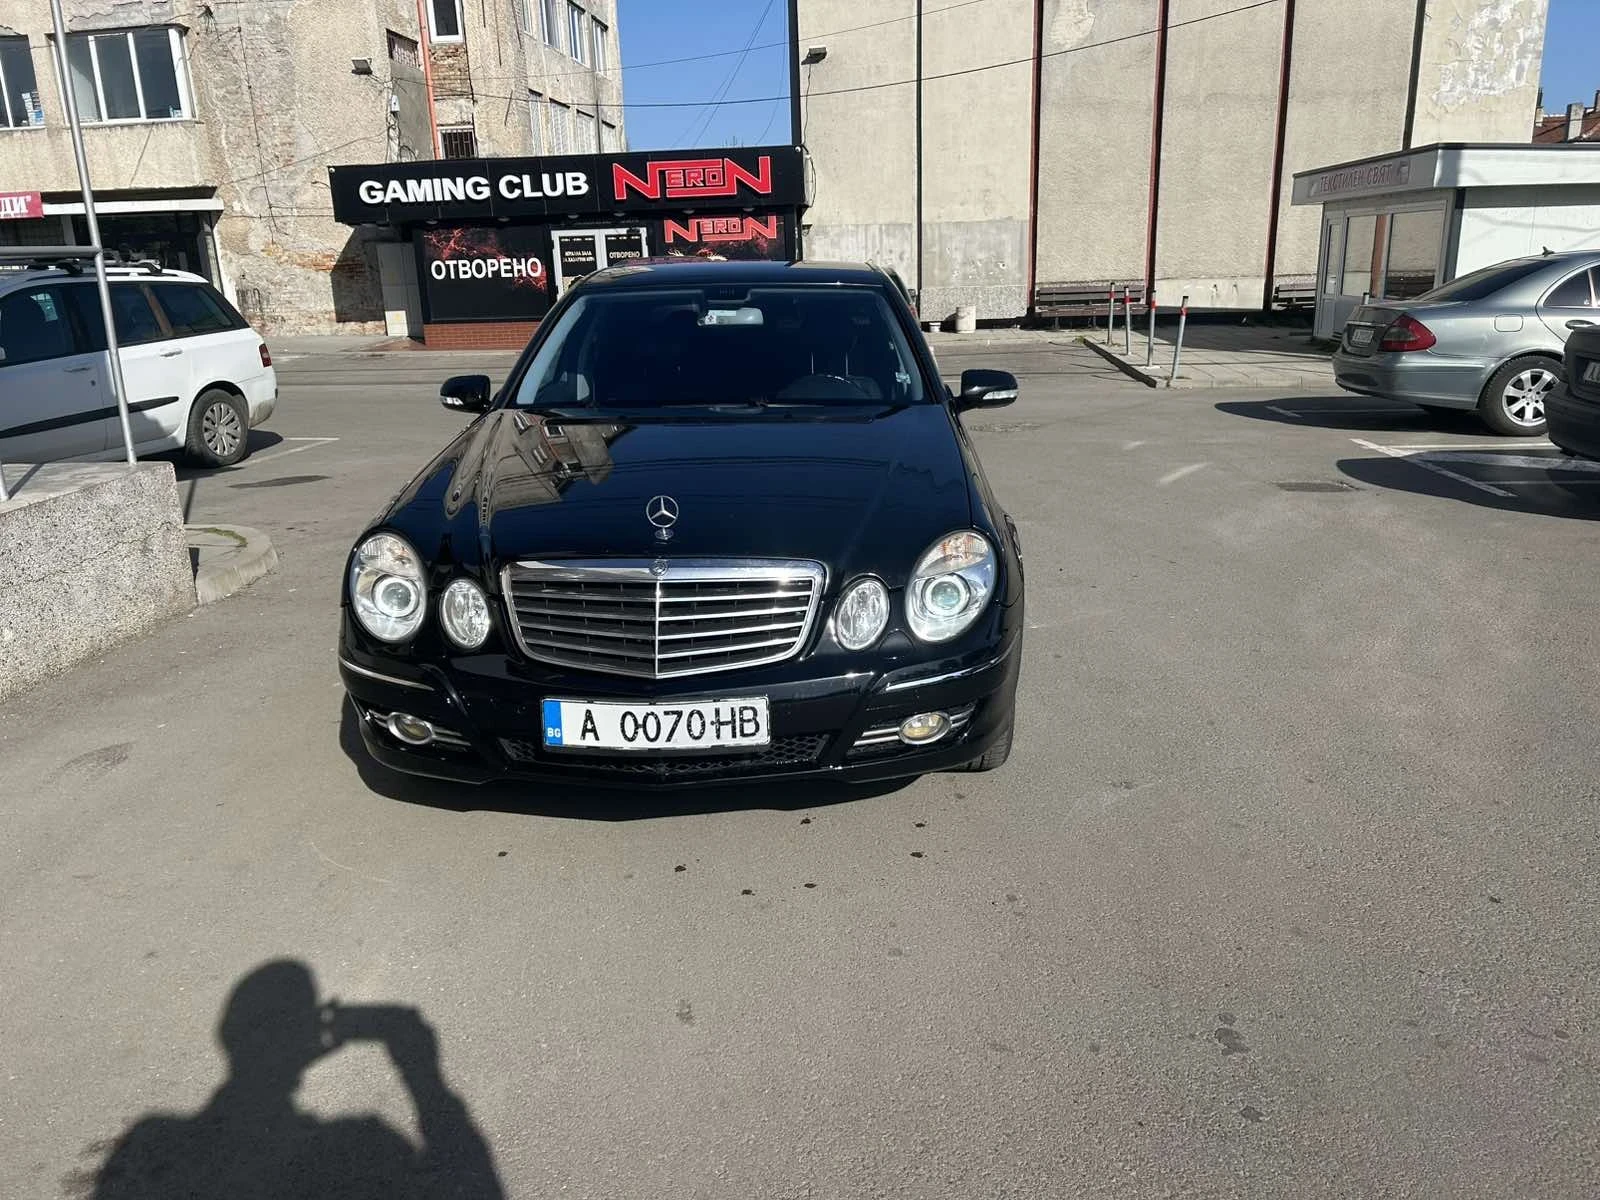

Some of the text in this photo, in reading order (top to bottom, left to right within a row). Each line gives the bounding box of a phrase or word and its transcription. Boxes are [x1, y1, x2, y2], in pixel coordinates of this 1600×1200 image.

[358, 155, 772, 204] GAMING CLUB NERON
[664, 213, 777, 243] NERON
[431, 256, 543, 281] ОТВОРЕНО
[609, 251, 641, 259] ОТВОРЕНО
[547, 727, 561, 738] BG
[580, 709, 600, 741] A
